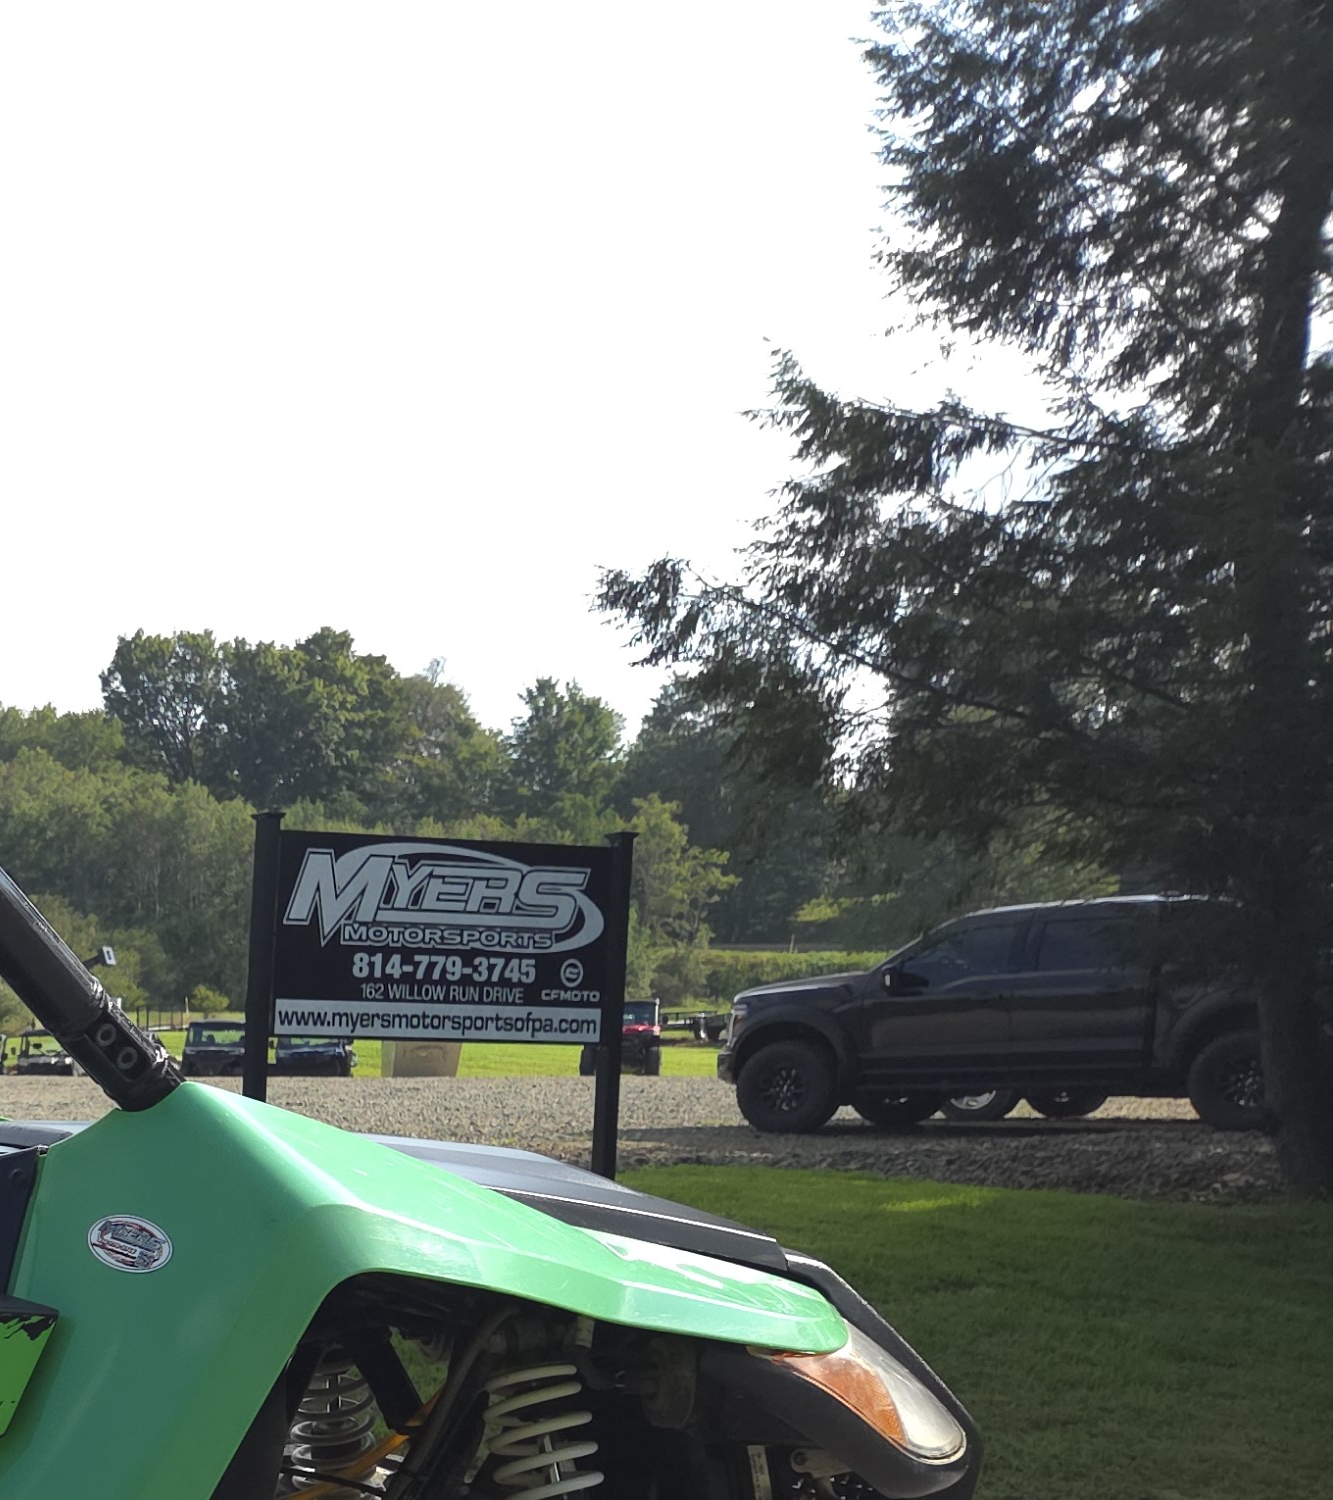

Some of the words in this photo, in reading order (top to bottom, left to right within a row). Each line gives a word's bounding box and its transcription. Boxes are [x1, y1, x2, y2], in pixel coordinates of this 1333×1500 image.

[283, 848, 591, 947] MYERS
[342, 923, 553, 949] MOTORSPORTS
[352, 952, 536, 984] 814-779-3745
[360, 982, 385, 1000] 162
[388, 983, 447, 1002] WILLOW
[449, 985, 480, 1002] RUN
[483, 986, 524, 1004] DRIVE
[541, 989, 601, 1003] CFMOTO
[278, 1009, 597, 1039] www.myersmotorsportsofpa.com
